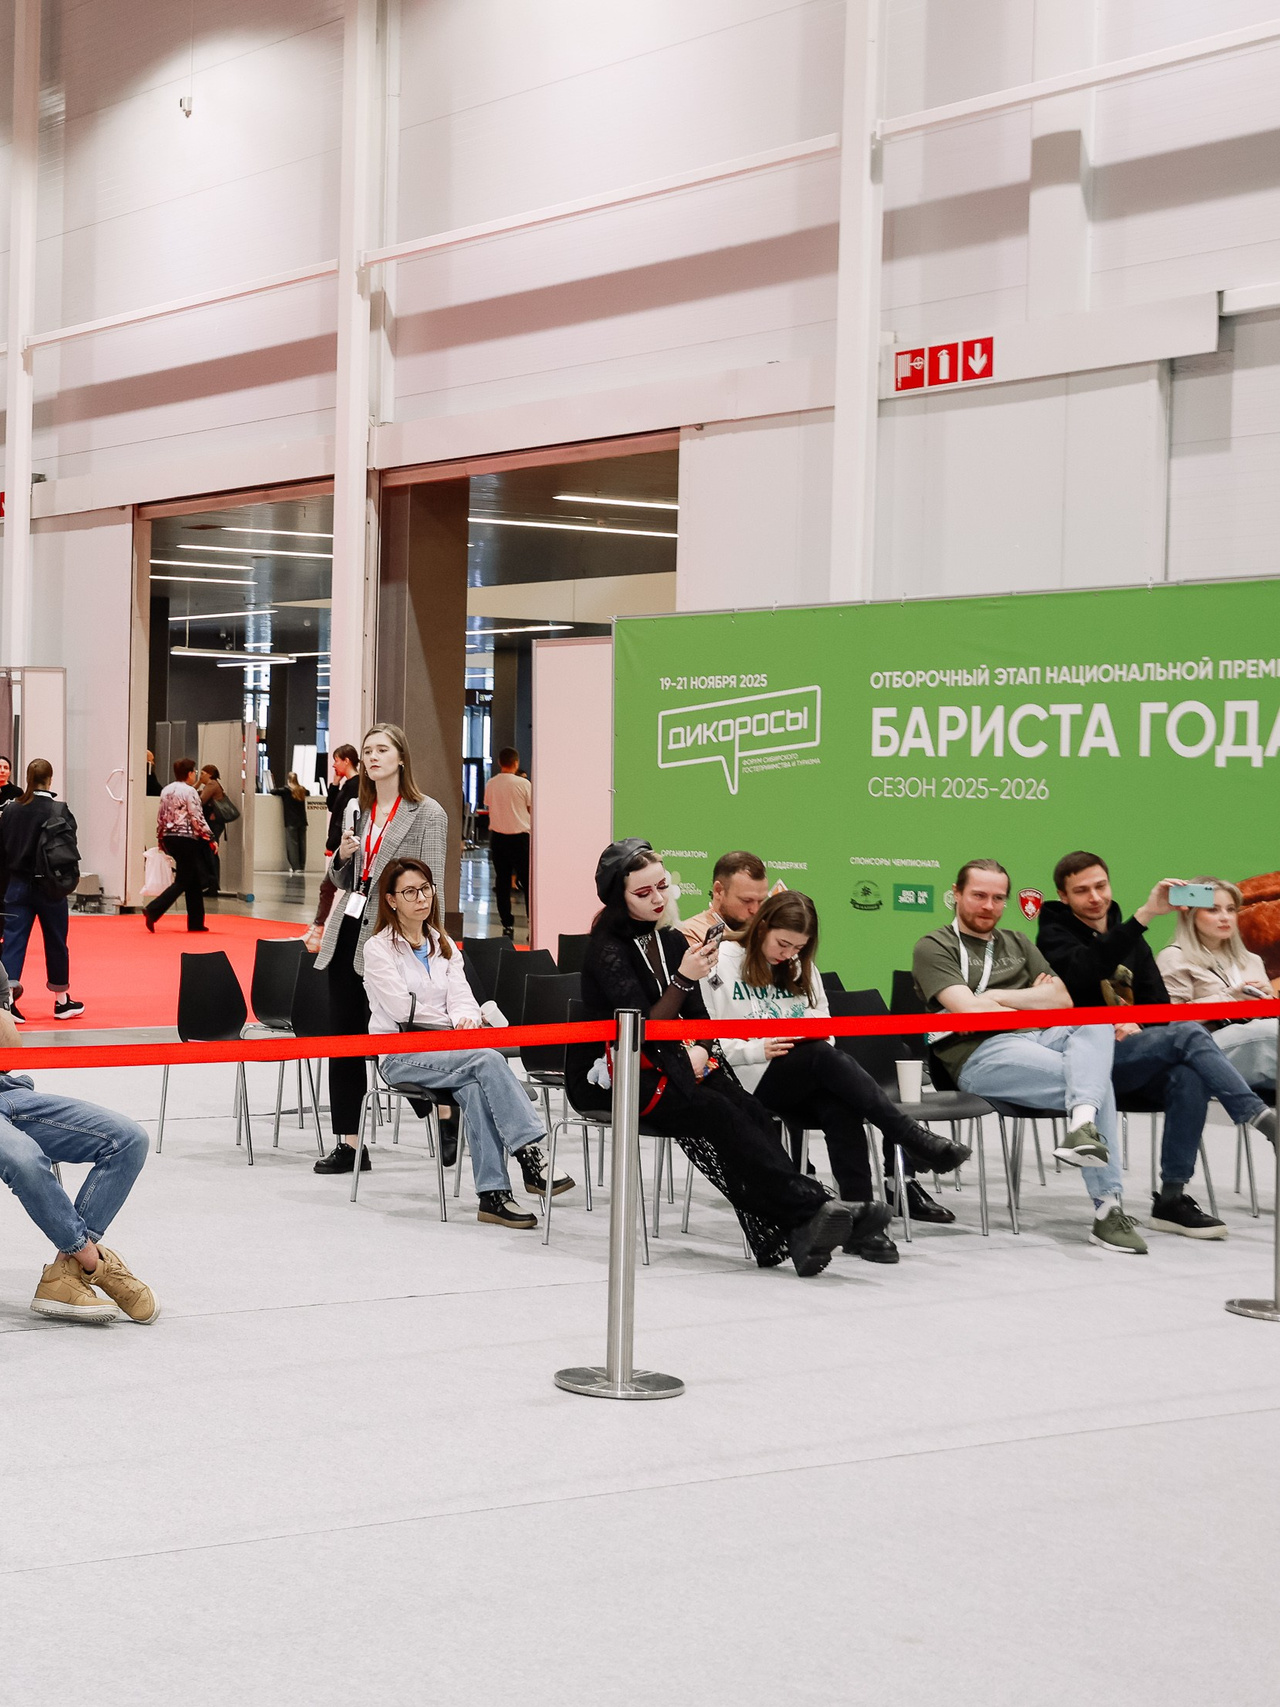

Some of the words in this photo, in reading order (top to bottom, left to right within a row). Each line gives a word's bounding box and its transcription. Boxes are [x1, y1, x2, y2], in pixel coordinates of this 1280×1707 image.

[659, 676, 688, 690] 19-21
[690, 675, 737, 689] НОЯБРЯ
[739, 674, 768, 688] 2025
[870, 664, 990, 690] ОТБОРОЧНЫЙ
[993, 666, 1041, 686] ЭТАП
[1045, 656, 1214, 687] НАЦИОНАЛЬНОЙ
[667, 706, 809, 750] ДИКОРОСЫ
[871, 703, 1121, 759] БАРИСТА
[868, 776, 936, 798] СЕЗОН
[941, 777, 1050, 800] 2025-2026
[661, 850, 708, 859] ОРГАНИЗАТОРЫ
[849, 856, 890, 866] СПОНСОРЫ
[892, 858, 941, 868] ЧЕМПИОНАТА
[767, 861, 808, 870] ПОДДЕРЖКЕ
